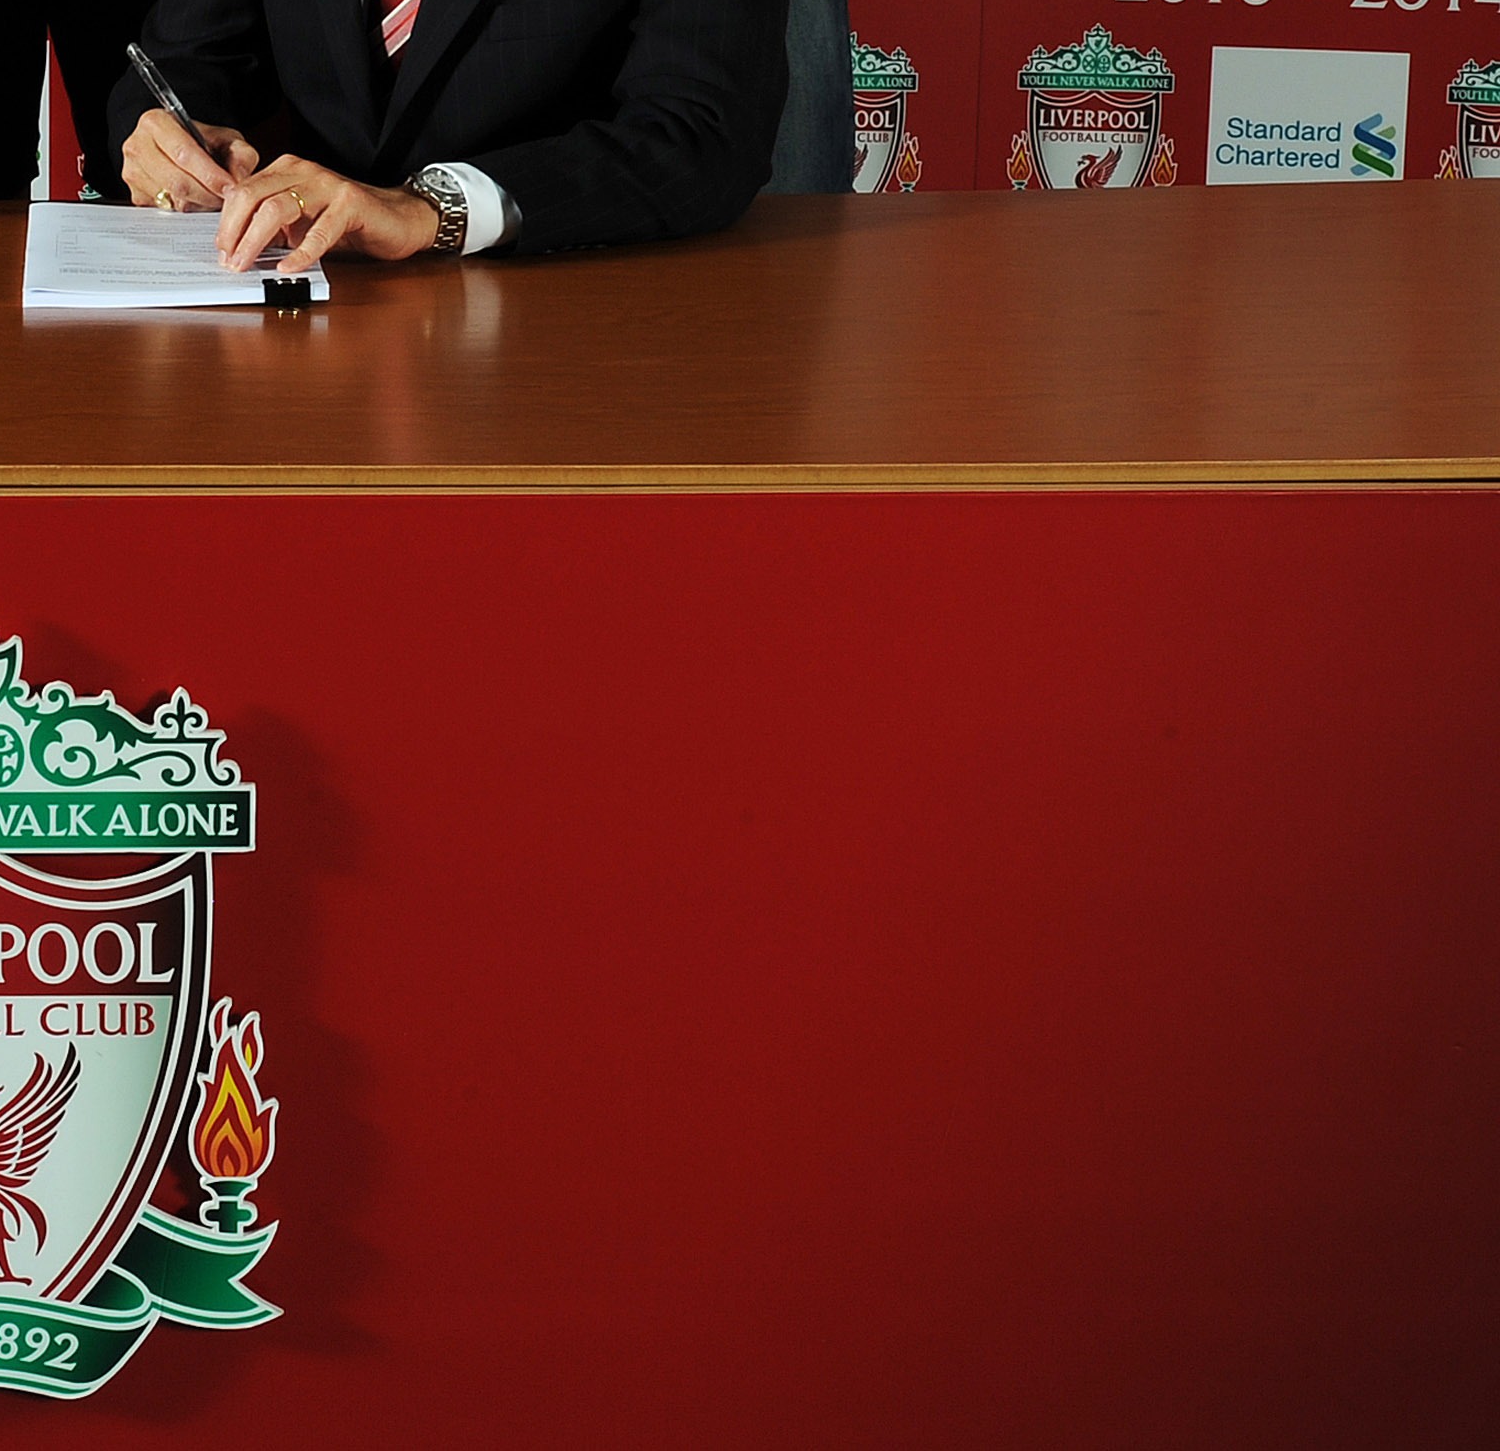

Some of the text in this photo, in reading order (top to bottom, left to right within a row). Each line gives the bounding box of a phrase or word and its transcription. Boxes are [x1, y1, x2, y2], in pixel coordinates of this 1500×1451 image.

[853, 77, 914, 88] ALK ALONE
[1021, 75, 1170, 89] YOU'LL NEVER WALK ALONE
[1450, 89, 1490, 101] YOU'LL
[1038, 109, 1150, 130] LIVERPOOL
[857, 132, 889, 143] CLUB
[1043, 131, 1144, 144] FOOTBALL CLUB
[1227, 117, 1341, 143] Standard
[1215, 144, 1340, 169] Chartered
[103, 804, 238, 836] ALONE
[40, 1003, 154, 1035] CLUB
